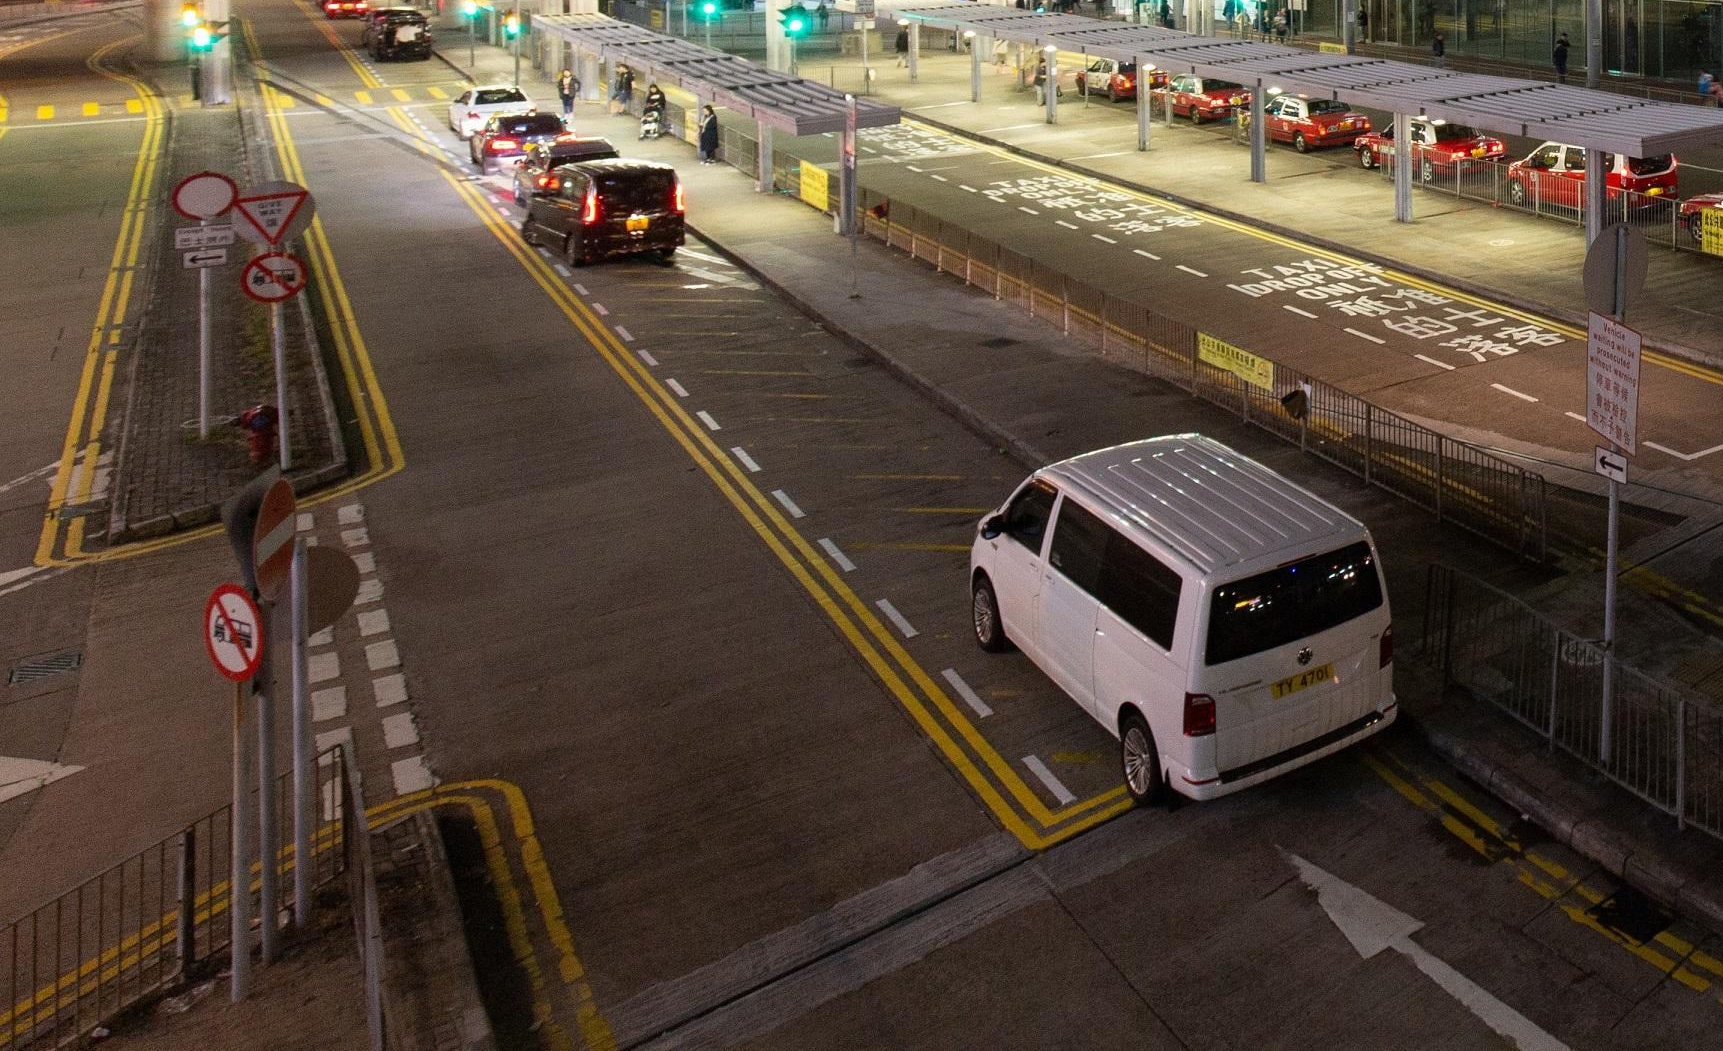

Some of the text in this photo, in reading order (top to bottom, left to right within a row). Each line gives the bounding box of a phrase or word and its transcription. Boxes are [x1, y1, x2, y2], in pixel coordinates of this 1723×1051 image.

[1241, 259, 1340, 280] TAXI
[1246, 262, 1385, 298] DROP OFF
[1295, 276, 1392, 300] ONLY
[1382, 307, 1505, 340] 的士
[1603, 322, 1626, 341] Vehicle
[1438, 325, 1566, 363] 落客
[1593, 333, 1635, 359] waiting will be
[1596, 347, 1631, 370] prosecuted
[1589, 355, 1637, 388] without warning
[1595, 371, 1629, 403] 停車等候
[1276, 680, 1294, 697] TY
[1300, 667, 1330, 687] 4701
